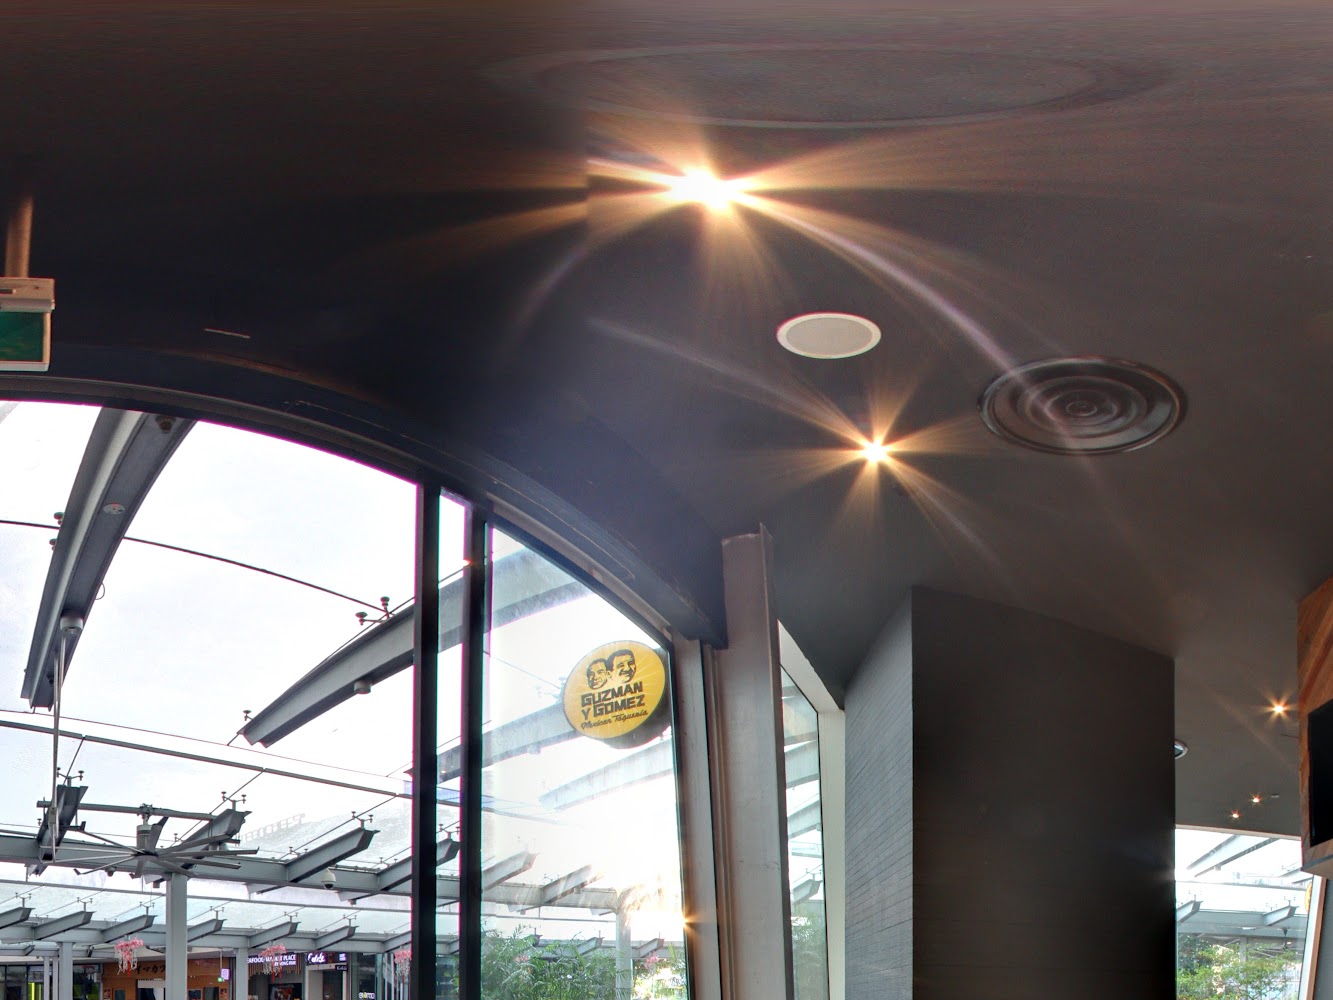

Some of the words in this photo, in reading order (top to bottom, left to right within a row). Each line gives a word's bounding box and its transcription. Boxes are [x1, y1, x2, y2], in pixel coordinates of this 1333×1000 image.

[580, 681, 644, 708] GUZMAN
[581, 708, 591, 721] Y
[593, 694, 646, 718] GOMEZ
[581, 719, 613, 731] Mexican
